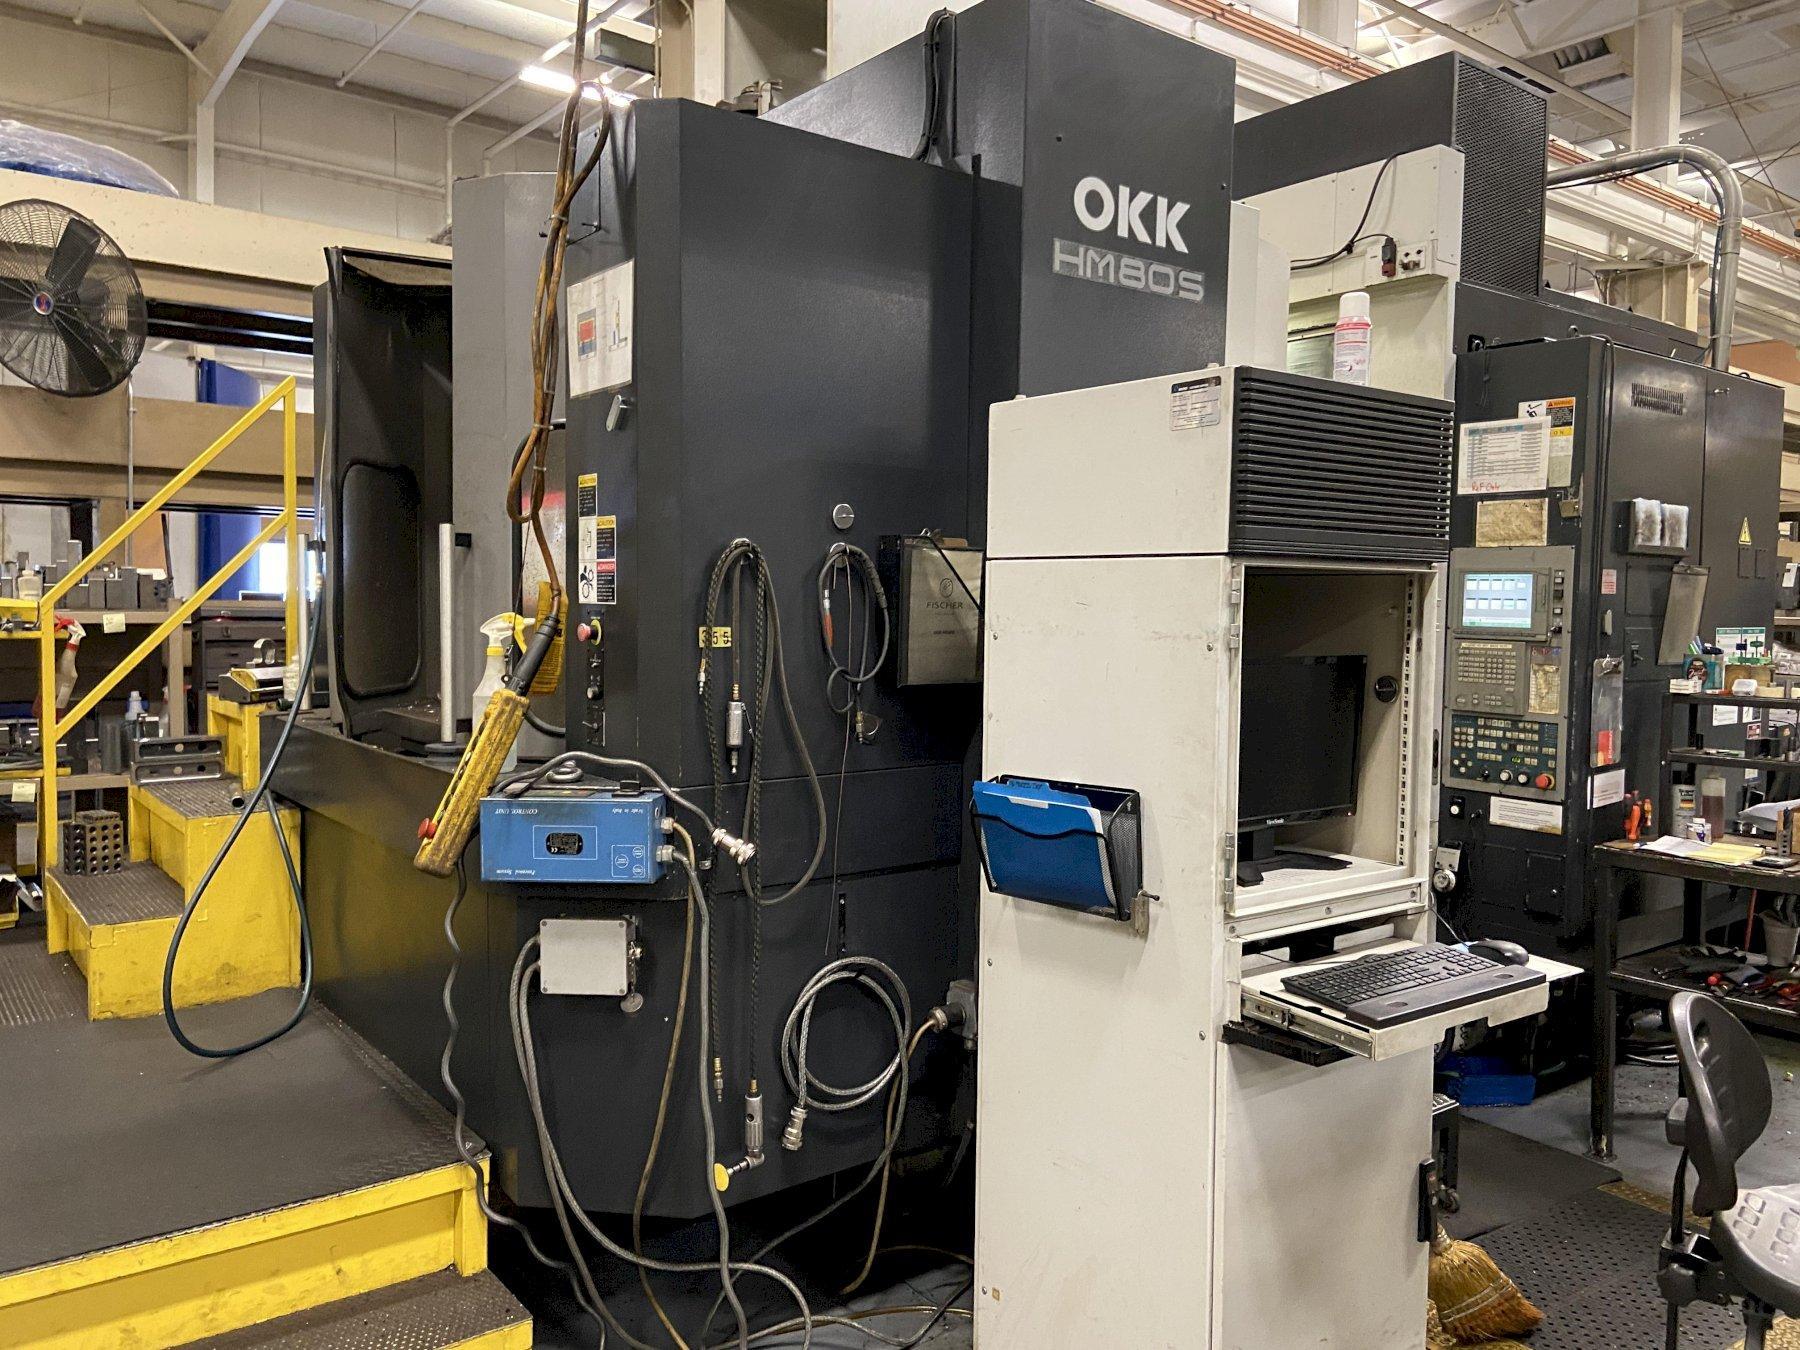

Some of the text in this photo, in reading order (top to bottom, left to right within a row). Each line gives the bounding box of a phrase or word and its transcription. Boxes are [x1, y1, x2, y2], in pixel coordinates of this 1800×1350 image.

[1074, 176, 1190, 254] OKK
[1053, 238, 1204, 302] HM80S
[926, 601, 963, 609] FISCHER
